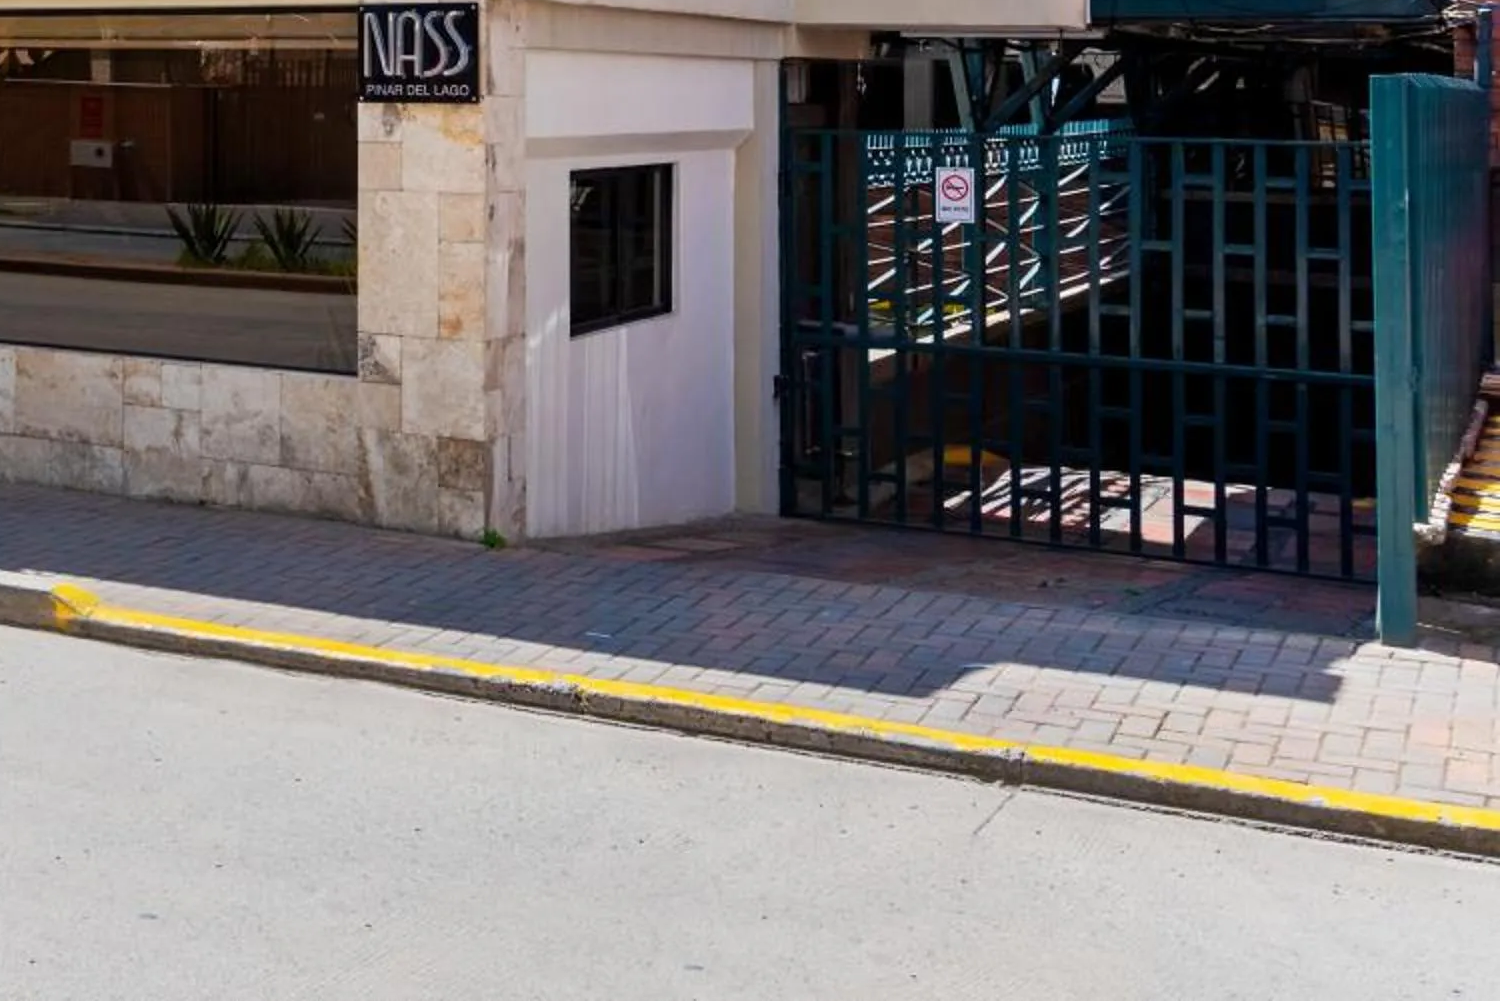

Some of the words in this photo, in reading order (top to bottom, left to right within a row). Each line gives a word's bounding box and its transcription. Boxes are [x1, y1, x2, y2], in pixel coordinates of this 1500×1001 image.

[363, 10, 470, 78] NASS
[365, 84, 404, 97] PINAR
[407, 84, 431, 97] DEL
[434, 84, 470, 97] LAGO
